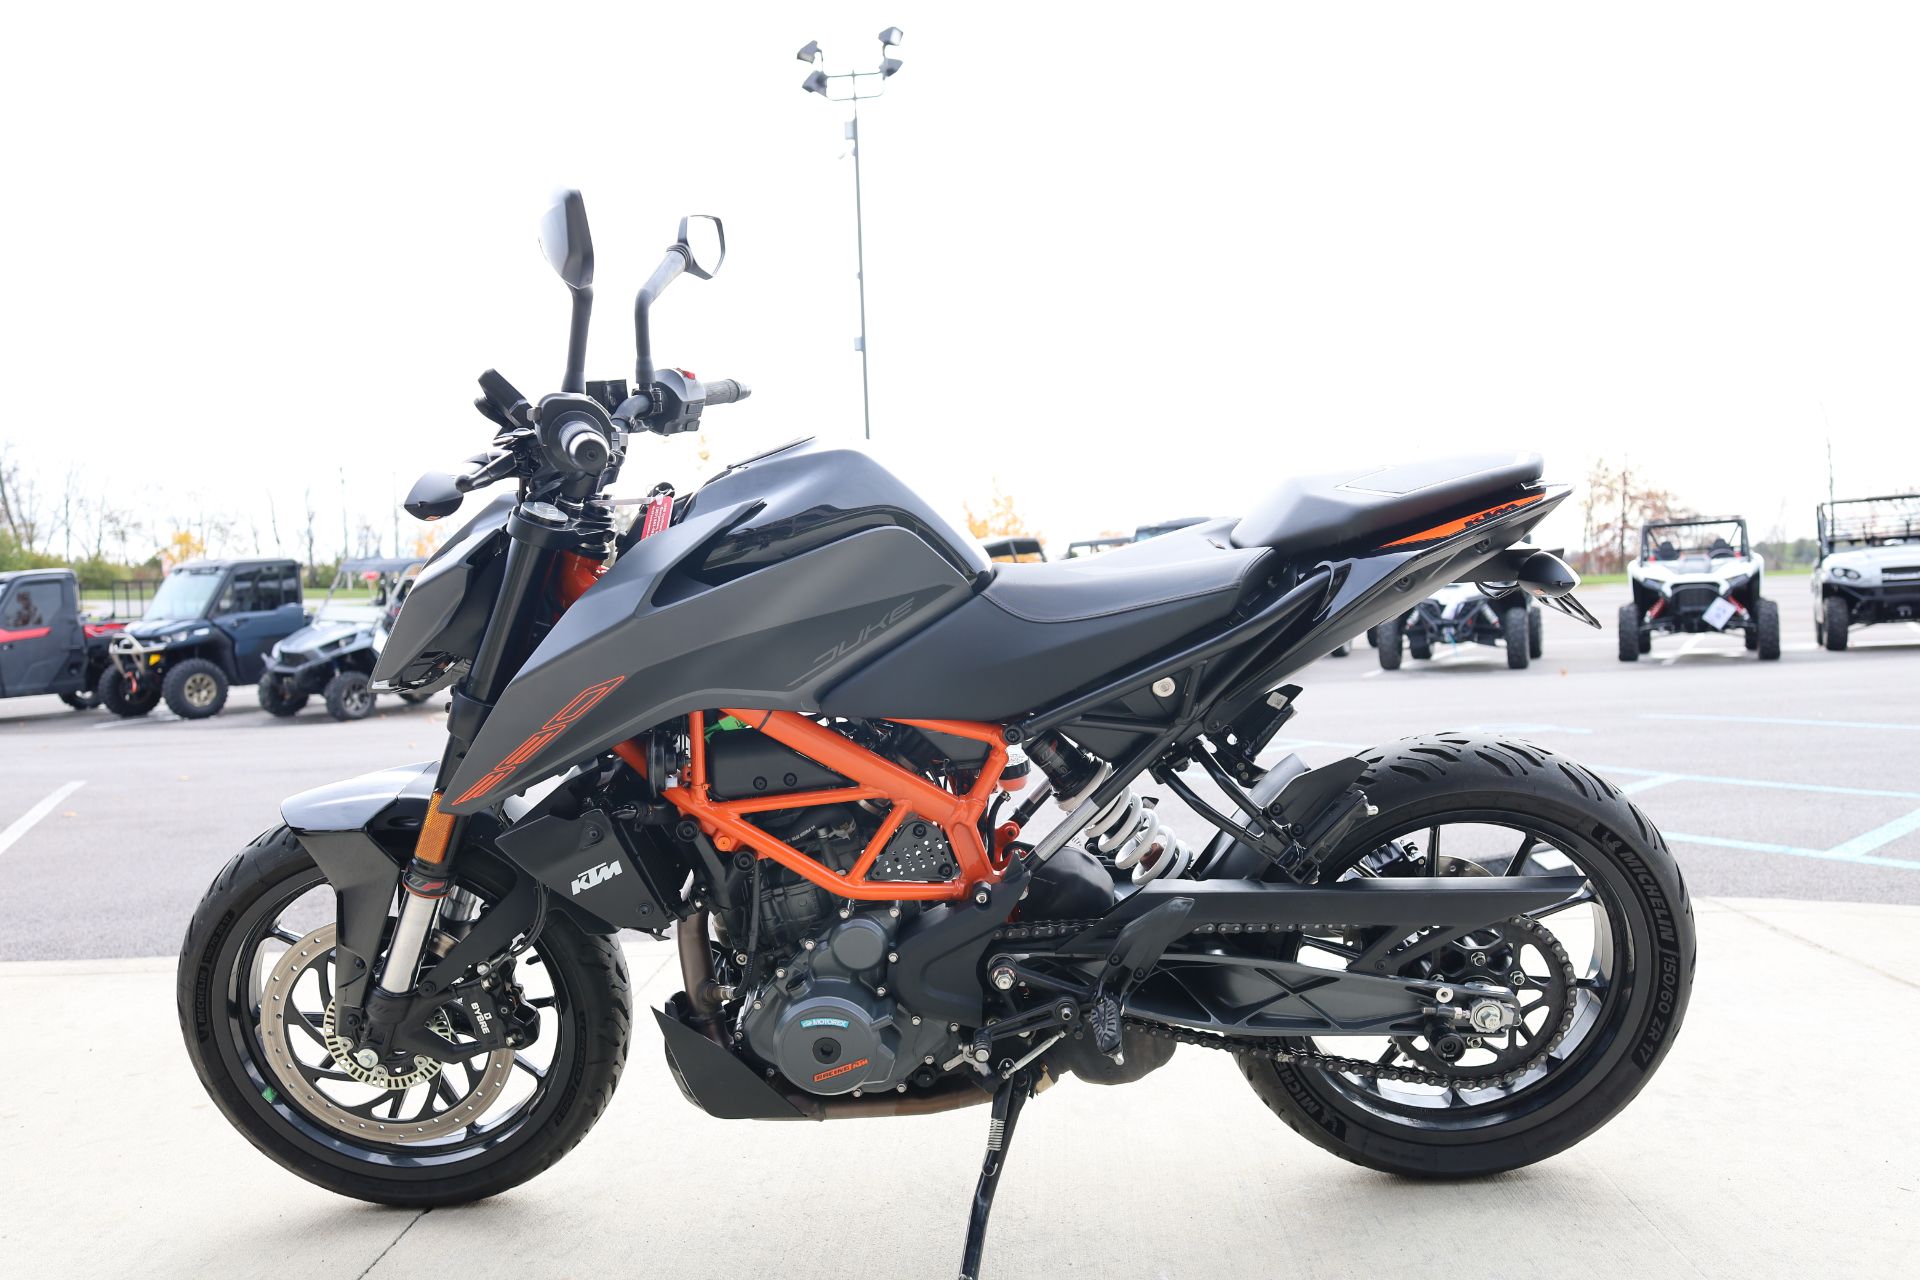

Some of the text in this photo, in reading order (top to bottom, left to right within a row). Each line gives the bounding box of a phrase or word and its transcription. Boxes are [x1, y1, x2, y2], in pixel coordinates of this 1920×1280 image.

[786, 597, 914, 687] DUKE
[571, 860, 622, 895] KTM
[1620, 852, 1677, 1062] MICHELIN 150/60 ZR 17
[471, 1002, 490, 1034] BYBRE
[813, 1018, 847, 1028] MOTOREX
